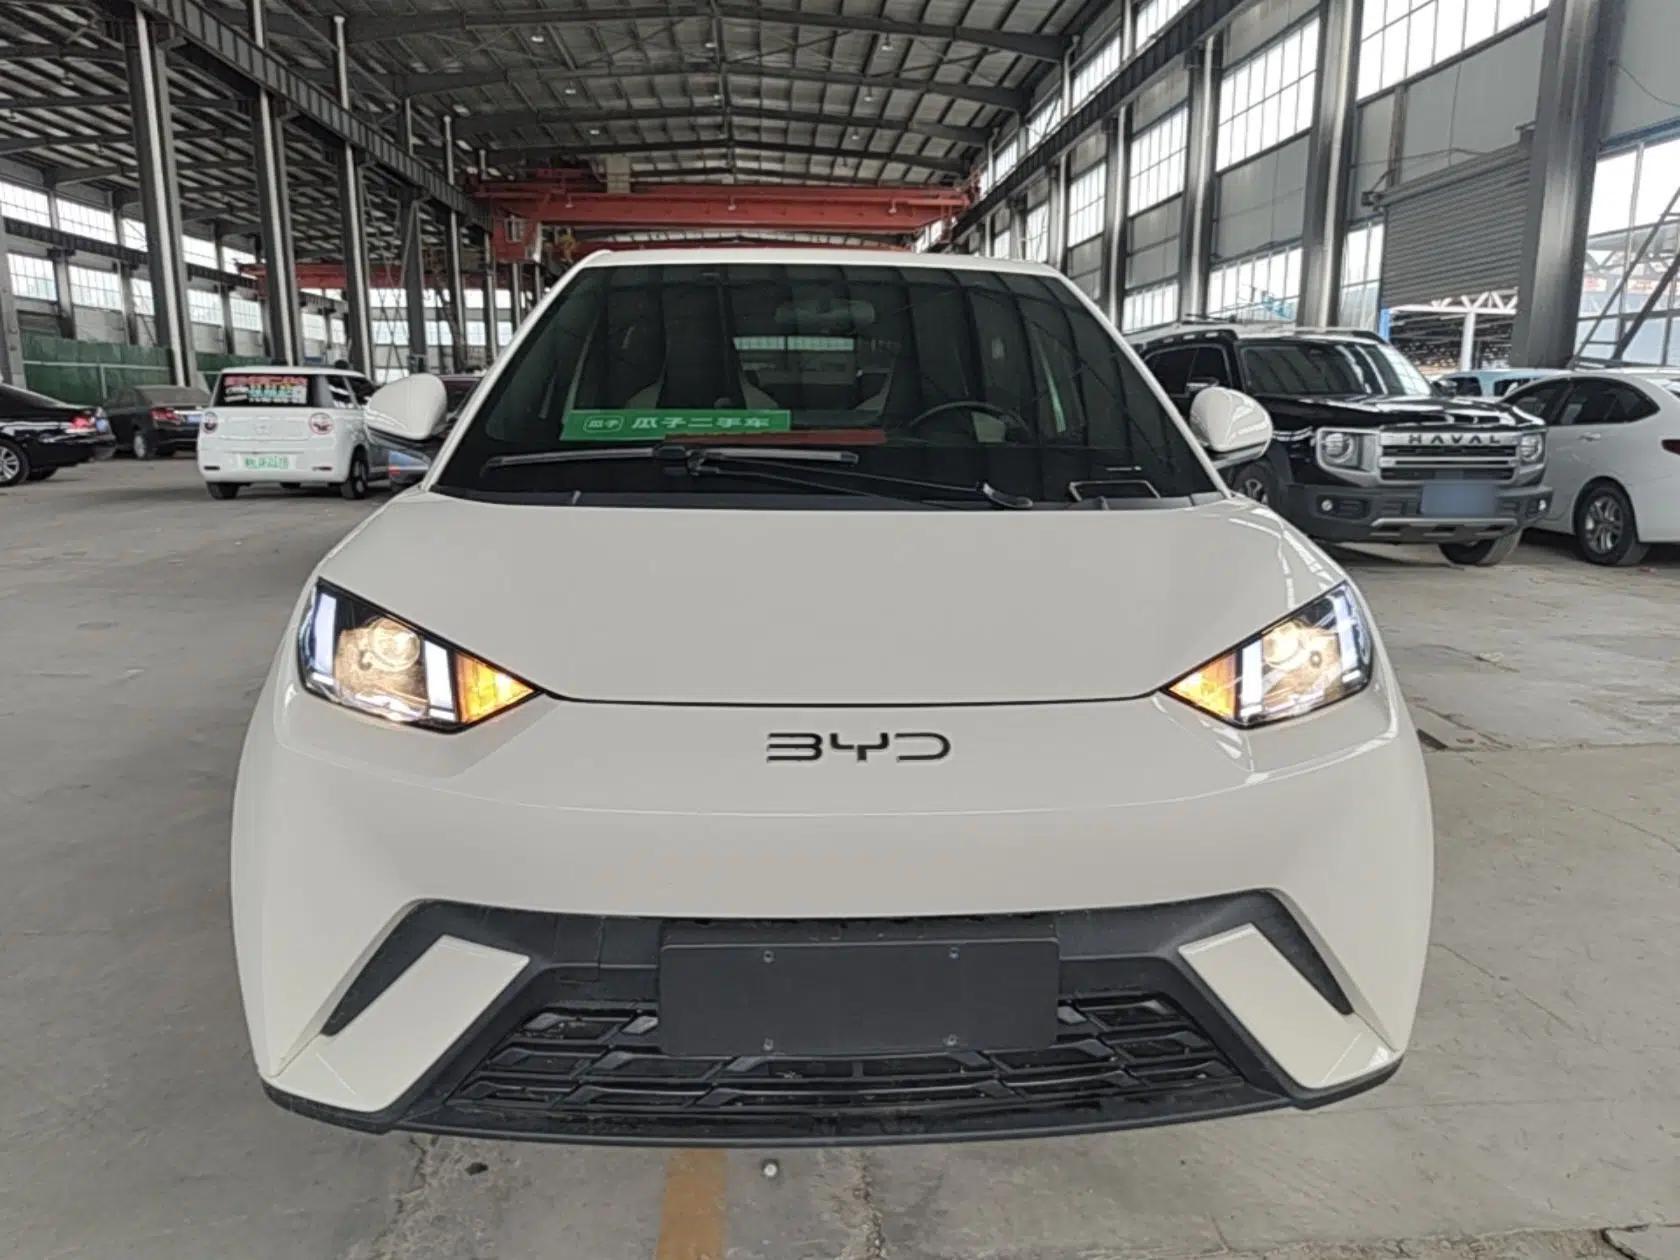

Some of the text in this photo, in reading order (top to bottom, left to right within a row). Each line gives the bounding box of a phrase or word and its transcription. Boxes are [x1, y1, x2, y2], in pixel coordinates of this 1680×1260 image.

[632, 416, 769, 429] 瓜子二手车
[1409, 434, 1500, 444] HAVAL
[767, 732, 951, 762] BYD
